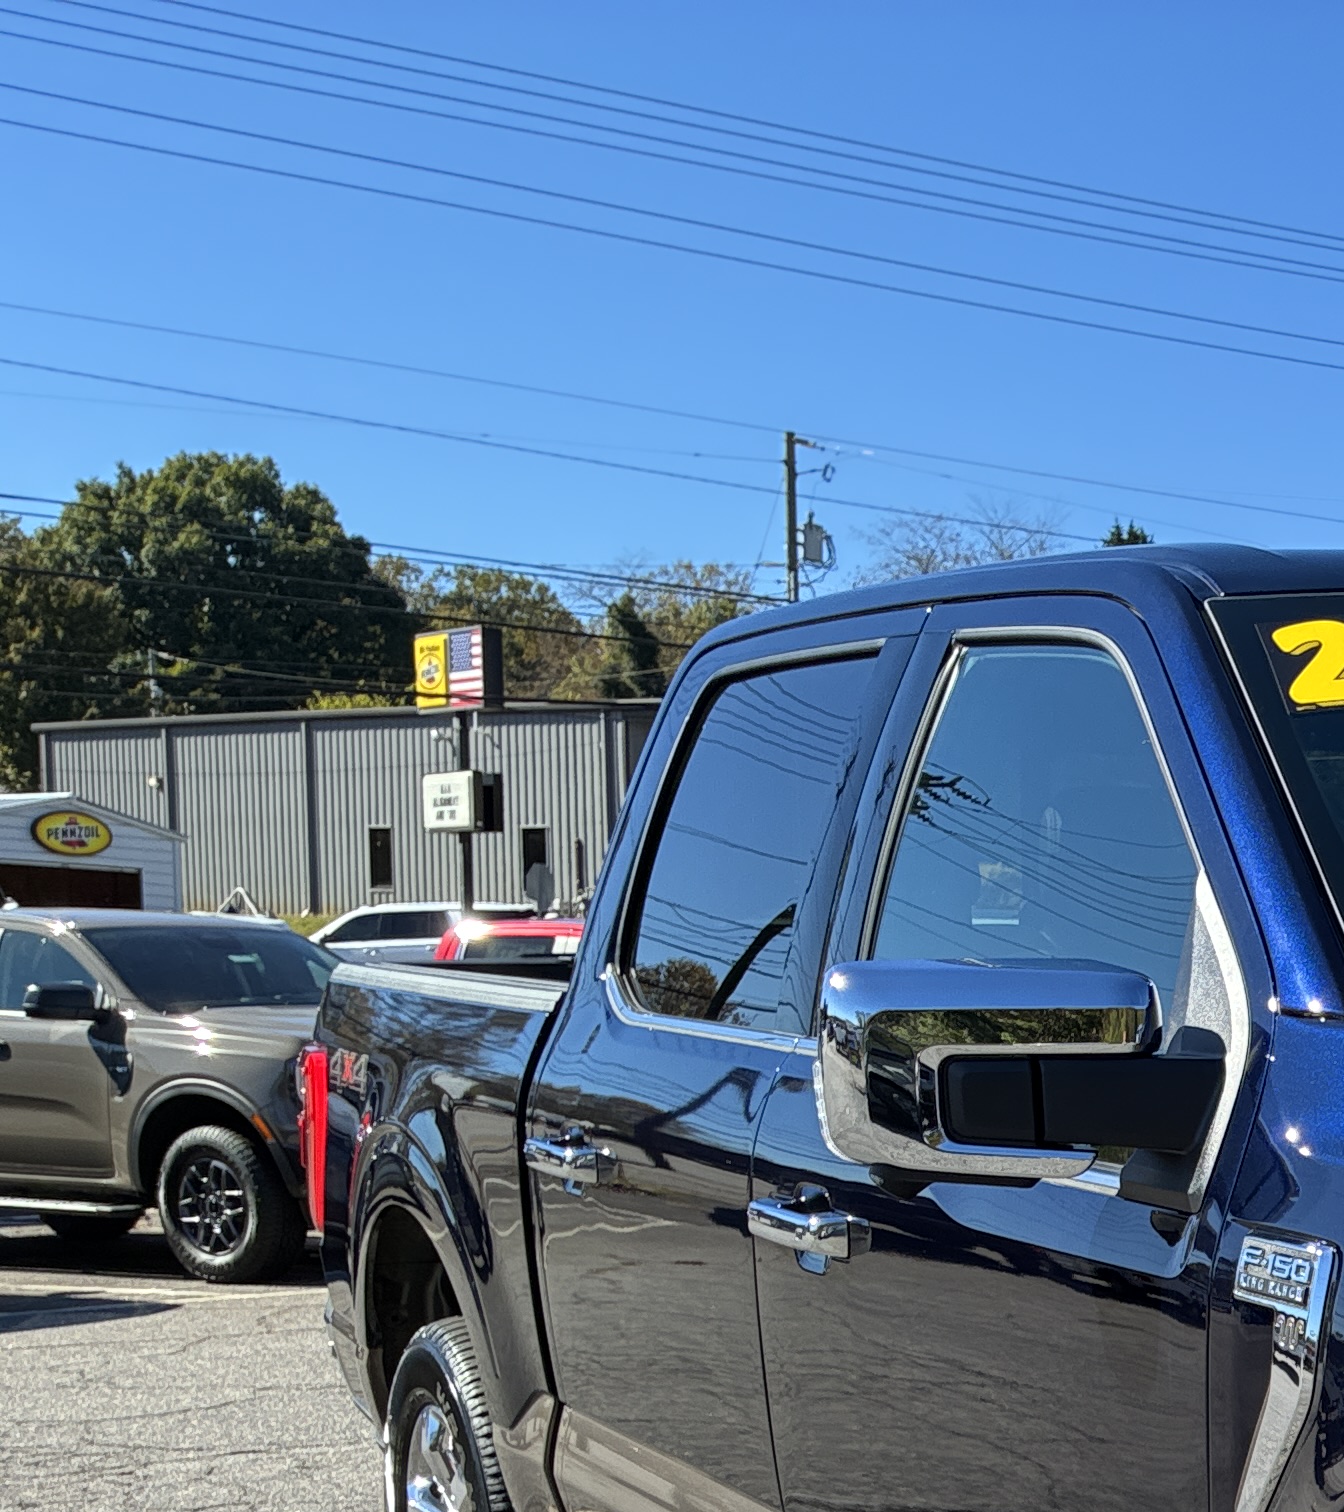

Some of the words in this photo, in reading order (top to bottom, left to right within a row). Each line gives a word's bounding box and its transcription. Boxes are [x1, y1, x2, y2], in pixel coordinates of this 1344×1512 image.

[46, 825, 101, 840] PENNZOIL
[1240, 1247, 1311, 1283] F-150
[1240, 1273, 1265, 1291] KING
[1267, 1281, 1303, 1302] RANCH
